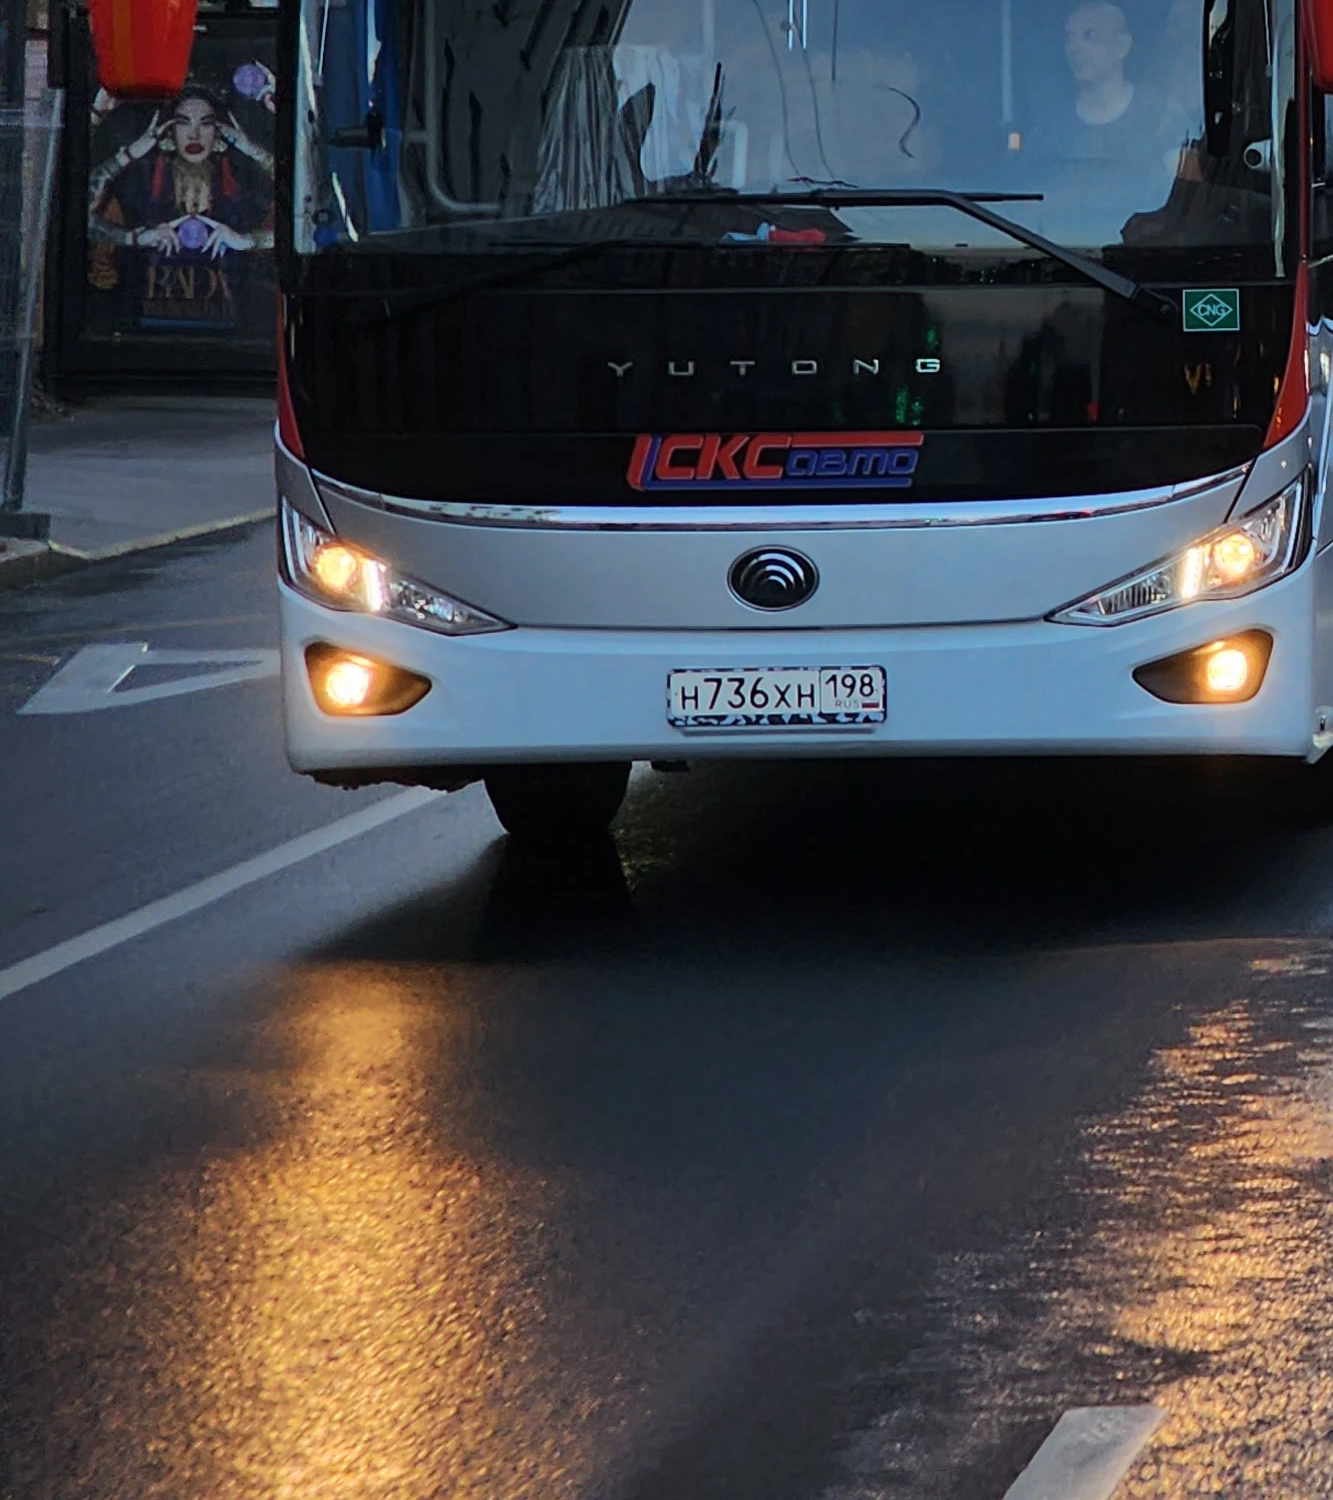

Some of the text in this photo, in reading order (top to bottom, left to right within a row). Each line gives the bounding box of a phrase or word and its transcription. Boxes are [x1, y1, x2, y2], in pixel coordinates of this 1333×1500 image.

[1197, 303, 1226, 317] CNG
[606, 357, 941, 377] YUTONG
[825, 673, 875, 699] 198
[834, 700, 860, 709] RUS
